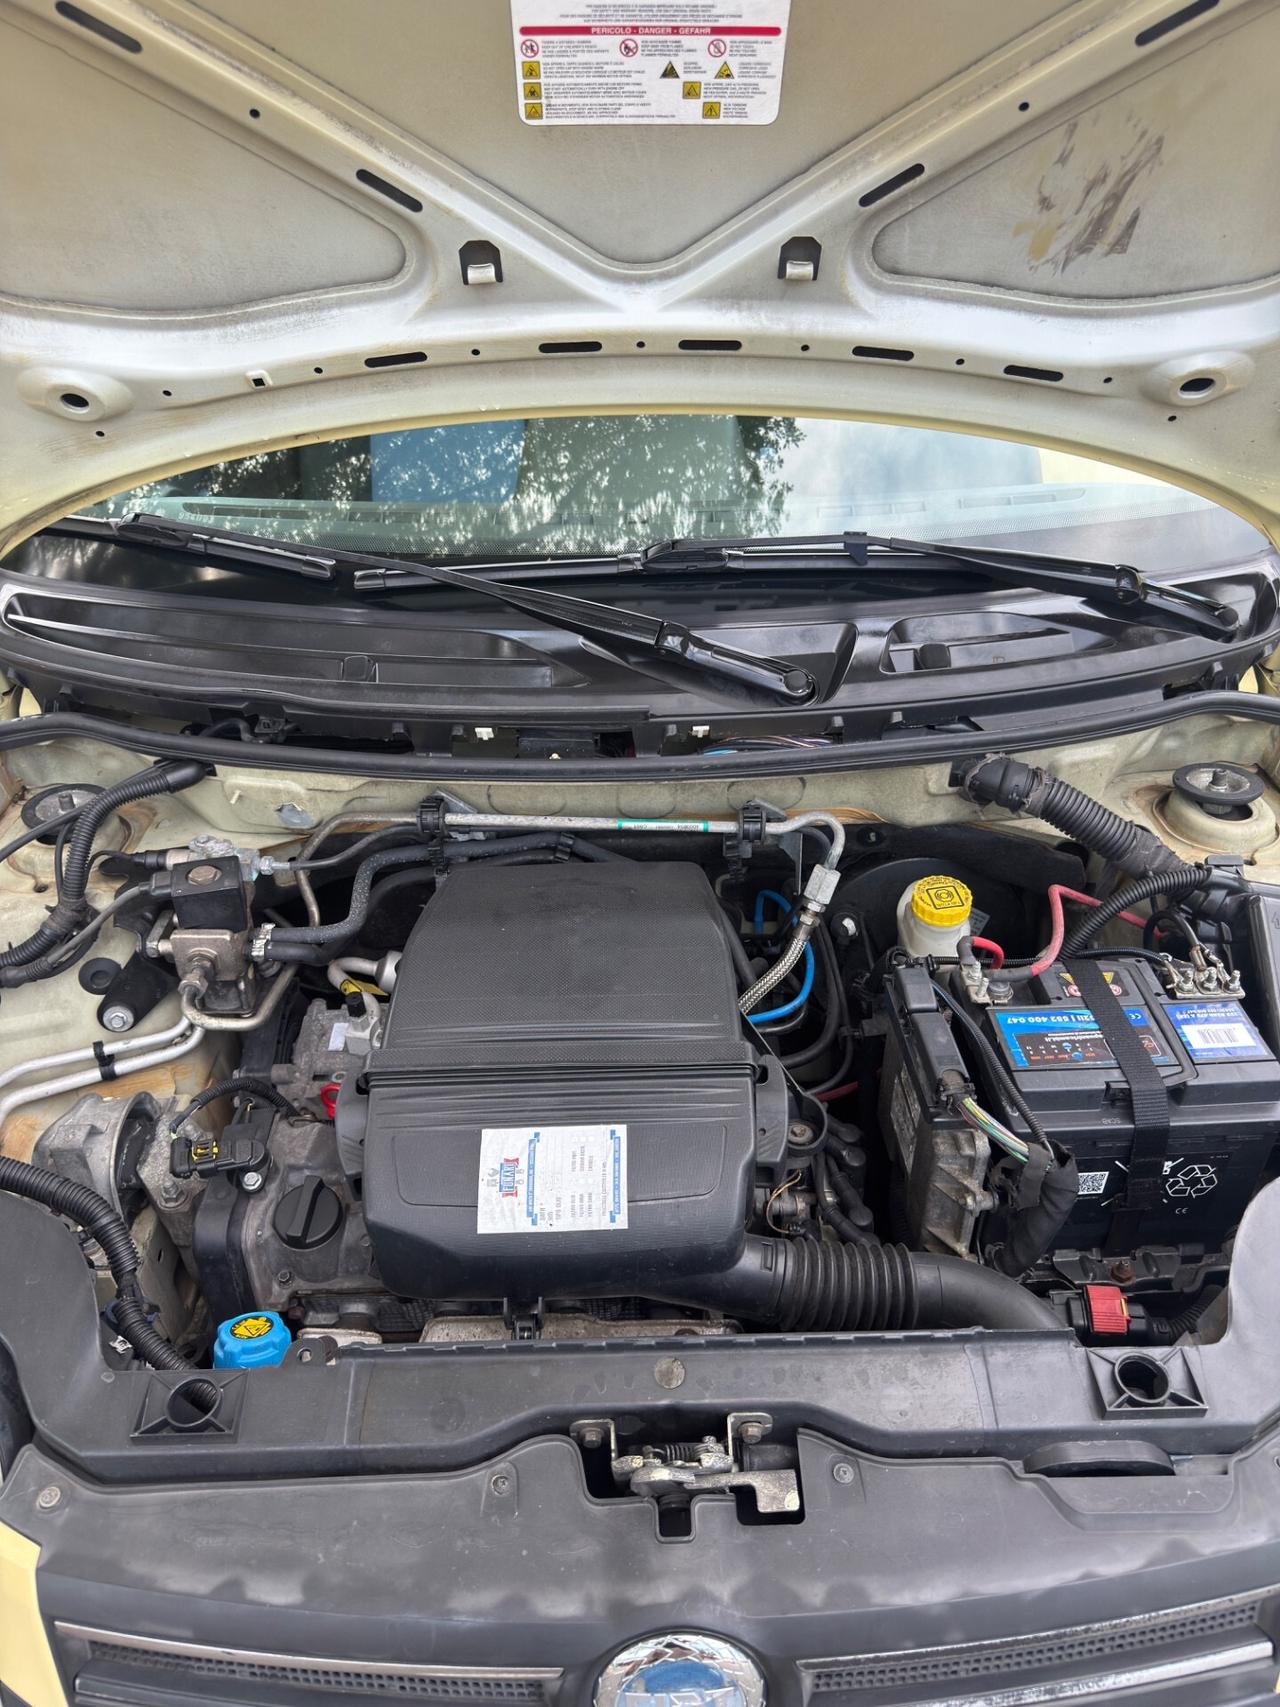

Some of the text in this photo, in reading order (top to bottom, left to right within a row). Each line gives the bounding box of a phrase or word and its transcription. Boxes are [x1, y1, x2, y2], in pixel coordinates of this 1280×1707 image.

[591, 27, 632, 35] PERICOLO
[638, 27, 672, 35] DANGER
[678, 26, 711, 35] GEFAHR
